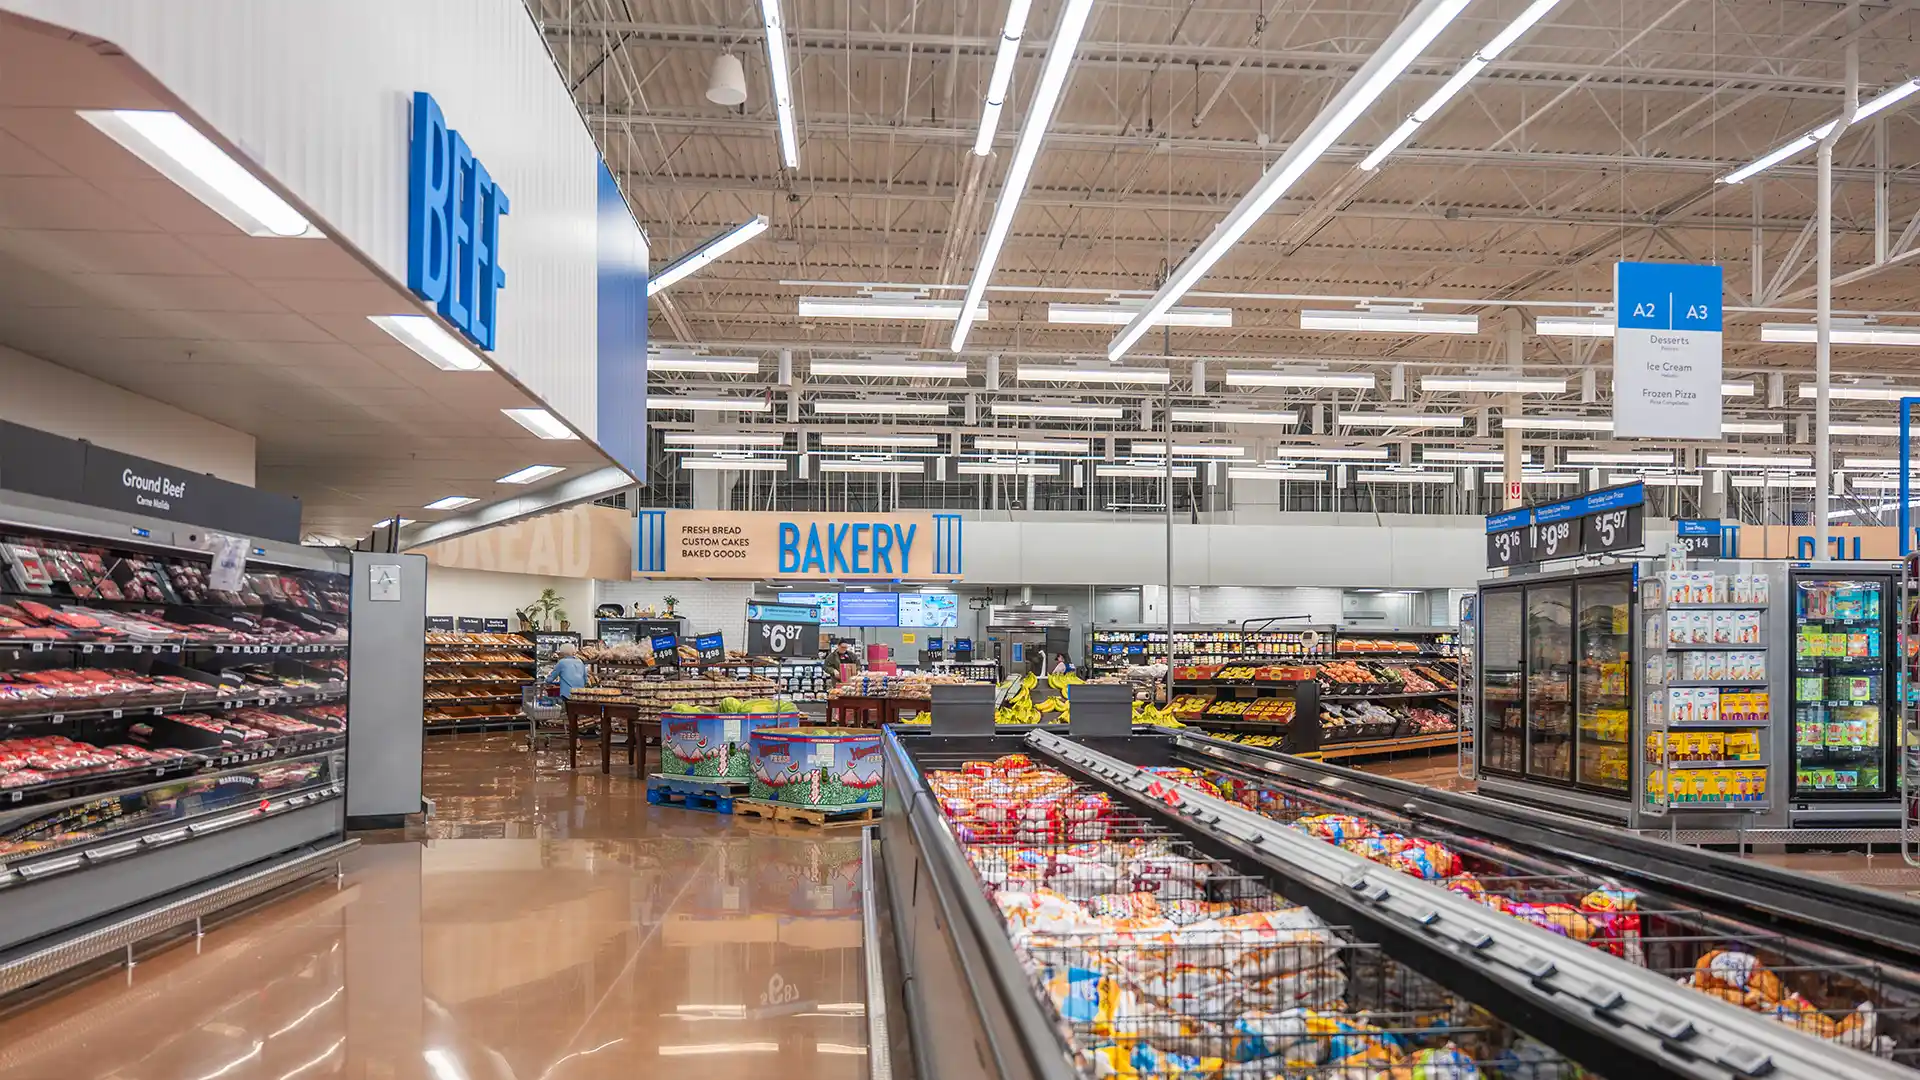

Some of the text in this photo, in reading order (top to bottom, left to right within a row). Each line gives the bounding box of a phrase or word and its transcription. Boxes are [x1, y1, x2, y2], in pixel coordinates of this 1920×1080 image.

[408, 91, 509, 352] BEEF
[1633, 303, 1656, 318] A2
[1686, 305, 1708, 320] A3
[1650, 334, 1689, 345] Desserts
[1646, 361, 1692, 372] Ice Cream
[1642, 388, 1697, 399] Frozen Pizza
[122, 468, 185, 498] Ground Beef
[1613, 491, 1625, 499] Price
[682, 526, 742, 535] FRESH BREAD
[682, 537, 750, 547] CUSTOM CAKES
[778, 522, 917, 574] BAKERY
[682, 549, 746, 559] BAKED GOODS
